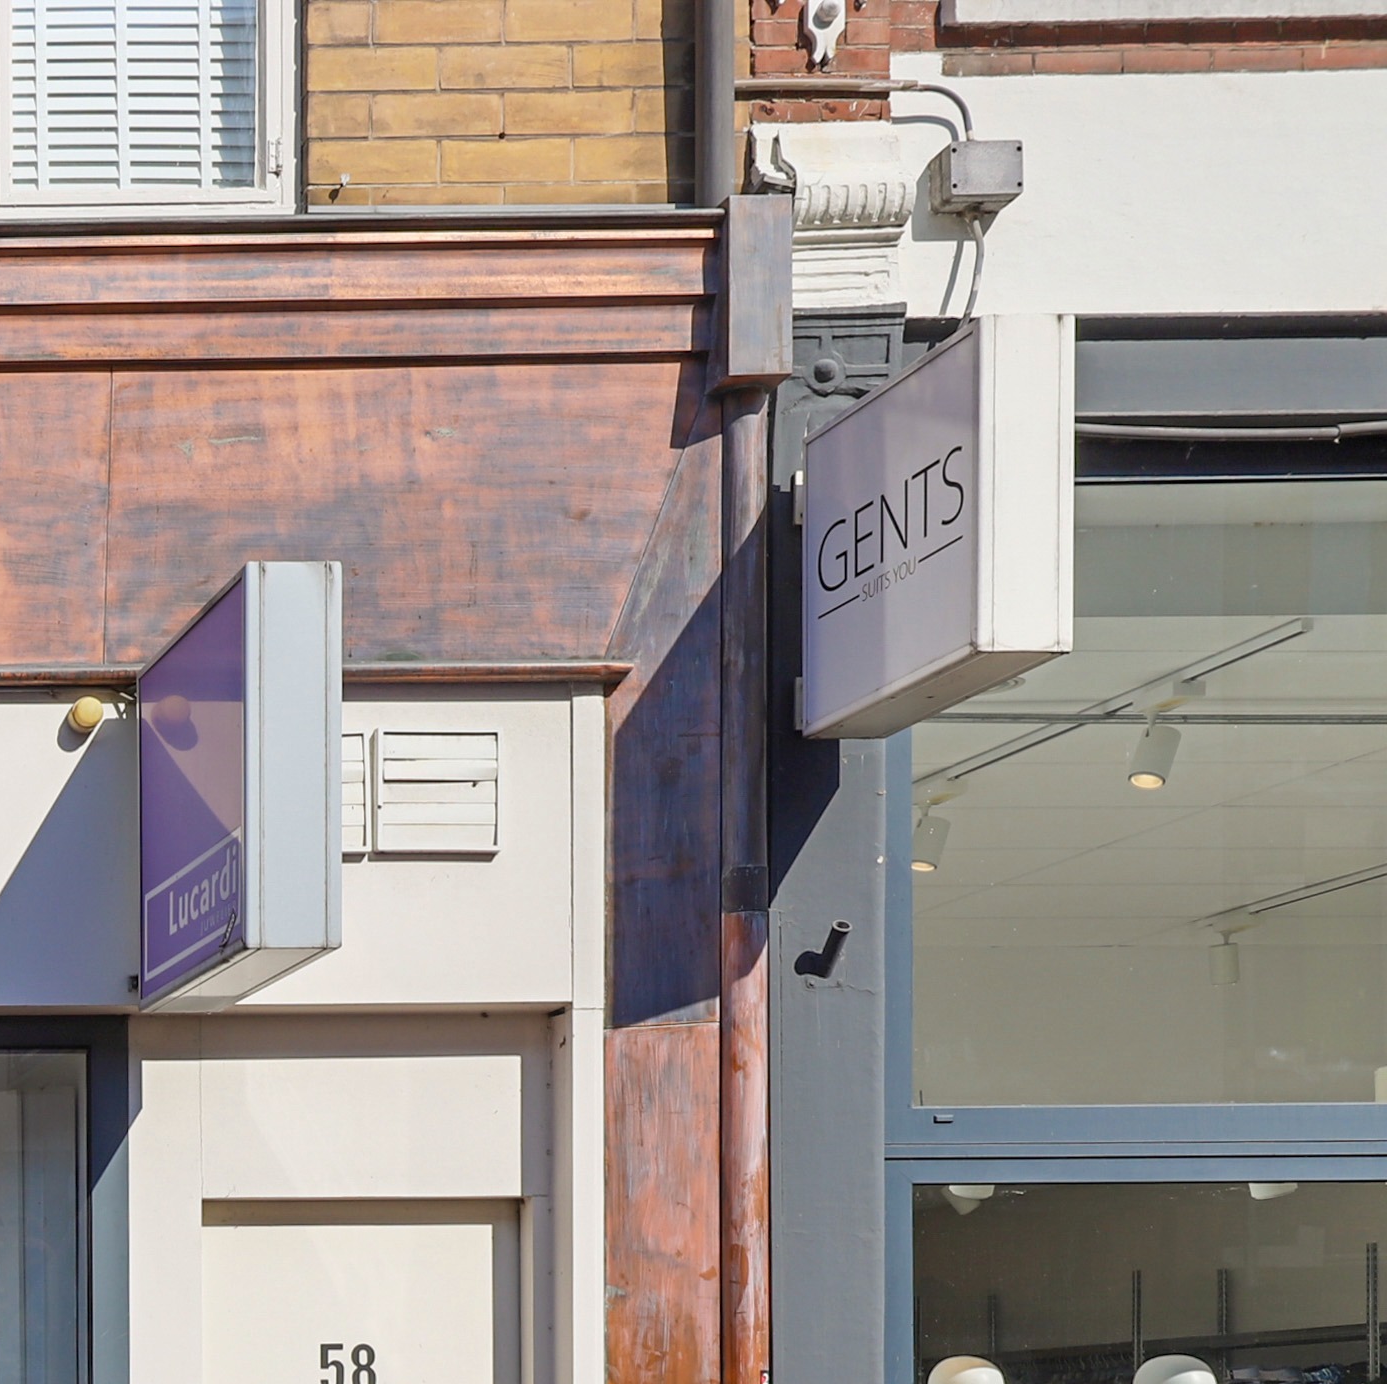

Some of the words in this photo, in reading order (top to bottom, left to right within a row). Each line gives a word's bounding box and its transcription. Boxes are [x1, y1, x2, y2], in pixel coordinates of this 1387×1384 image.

[817, 445, 964, 592] GENTS
[861, 569, 891, 602] SUITS
[892, 555, 917, 584] YOU
[169, 844, 236, 936] Lucardi
